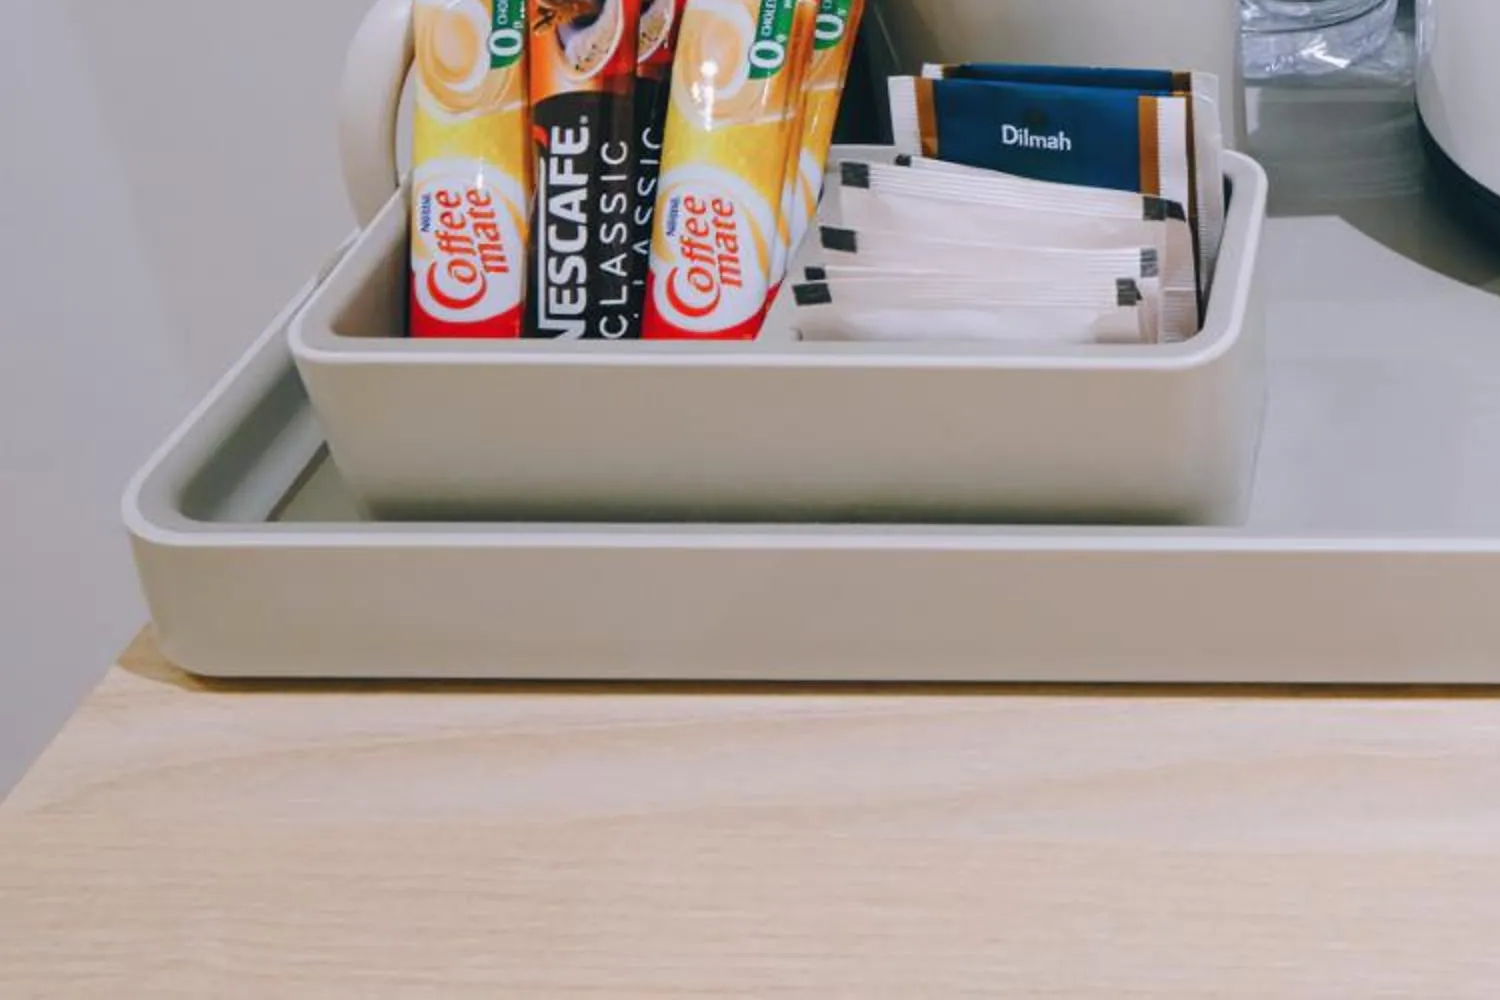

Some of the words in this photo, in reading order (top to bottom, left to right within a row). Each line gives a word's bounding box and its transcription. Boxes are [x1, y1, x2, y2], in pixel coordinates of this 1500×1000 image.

[1002, 124, 1072, 152] Dilmah
[427, 189, 487, 311] Coffee
[466, 187, 510, 274] mate
[599, 140, 629, 340] CLASSIC
[666, 195, 721, 317] Coffee
[711, 198, 743, 289] mate
